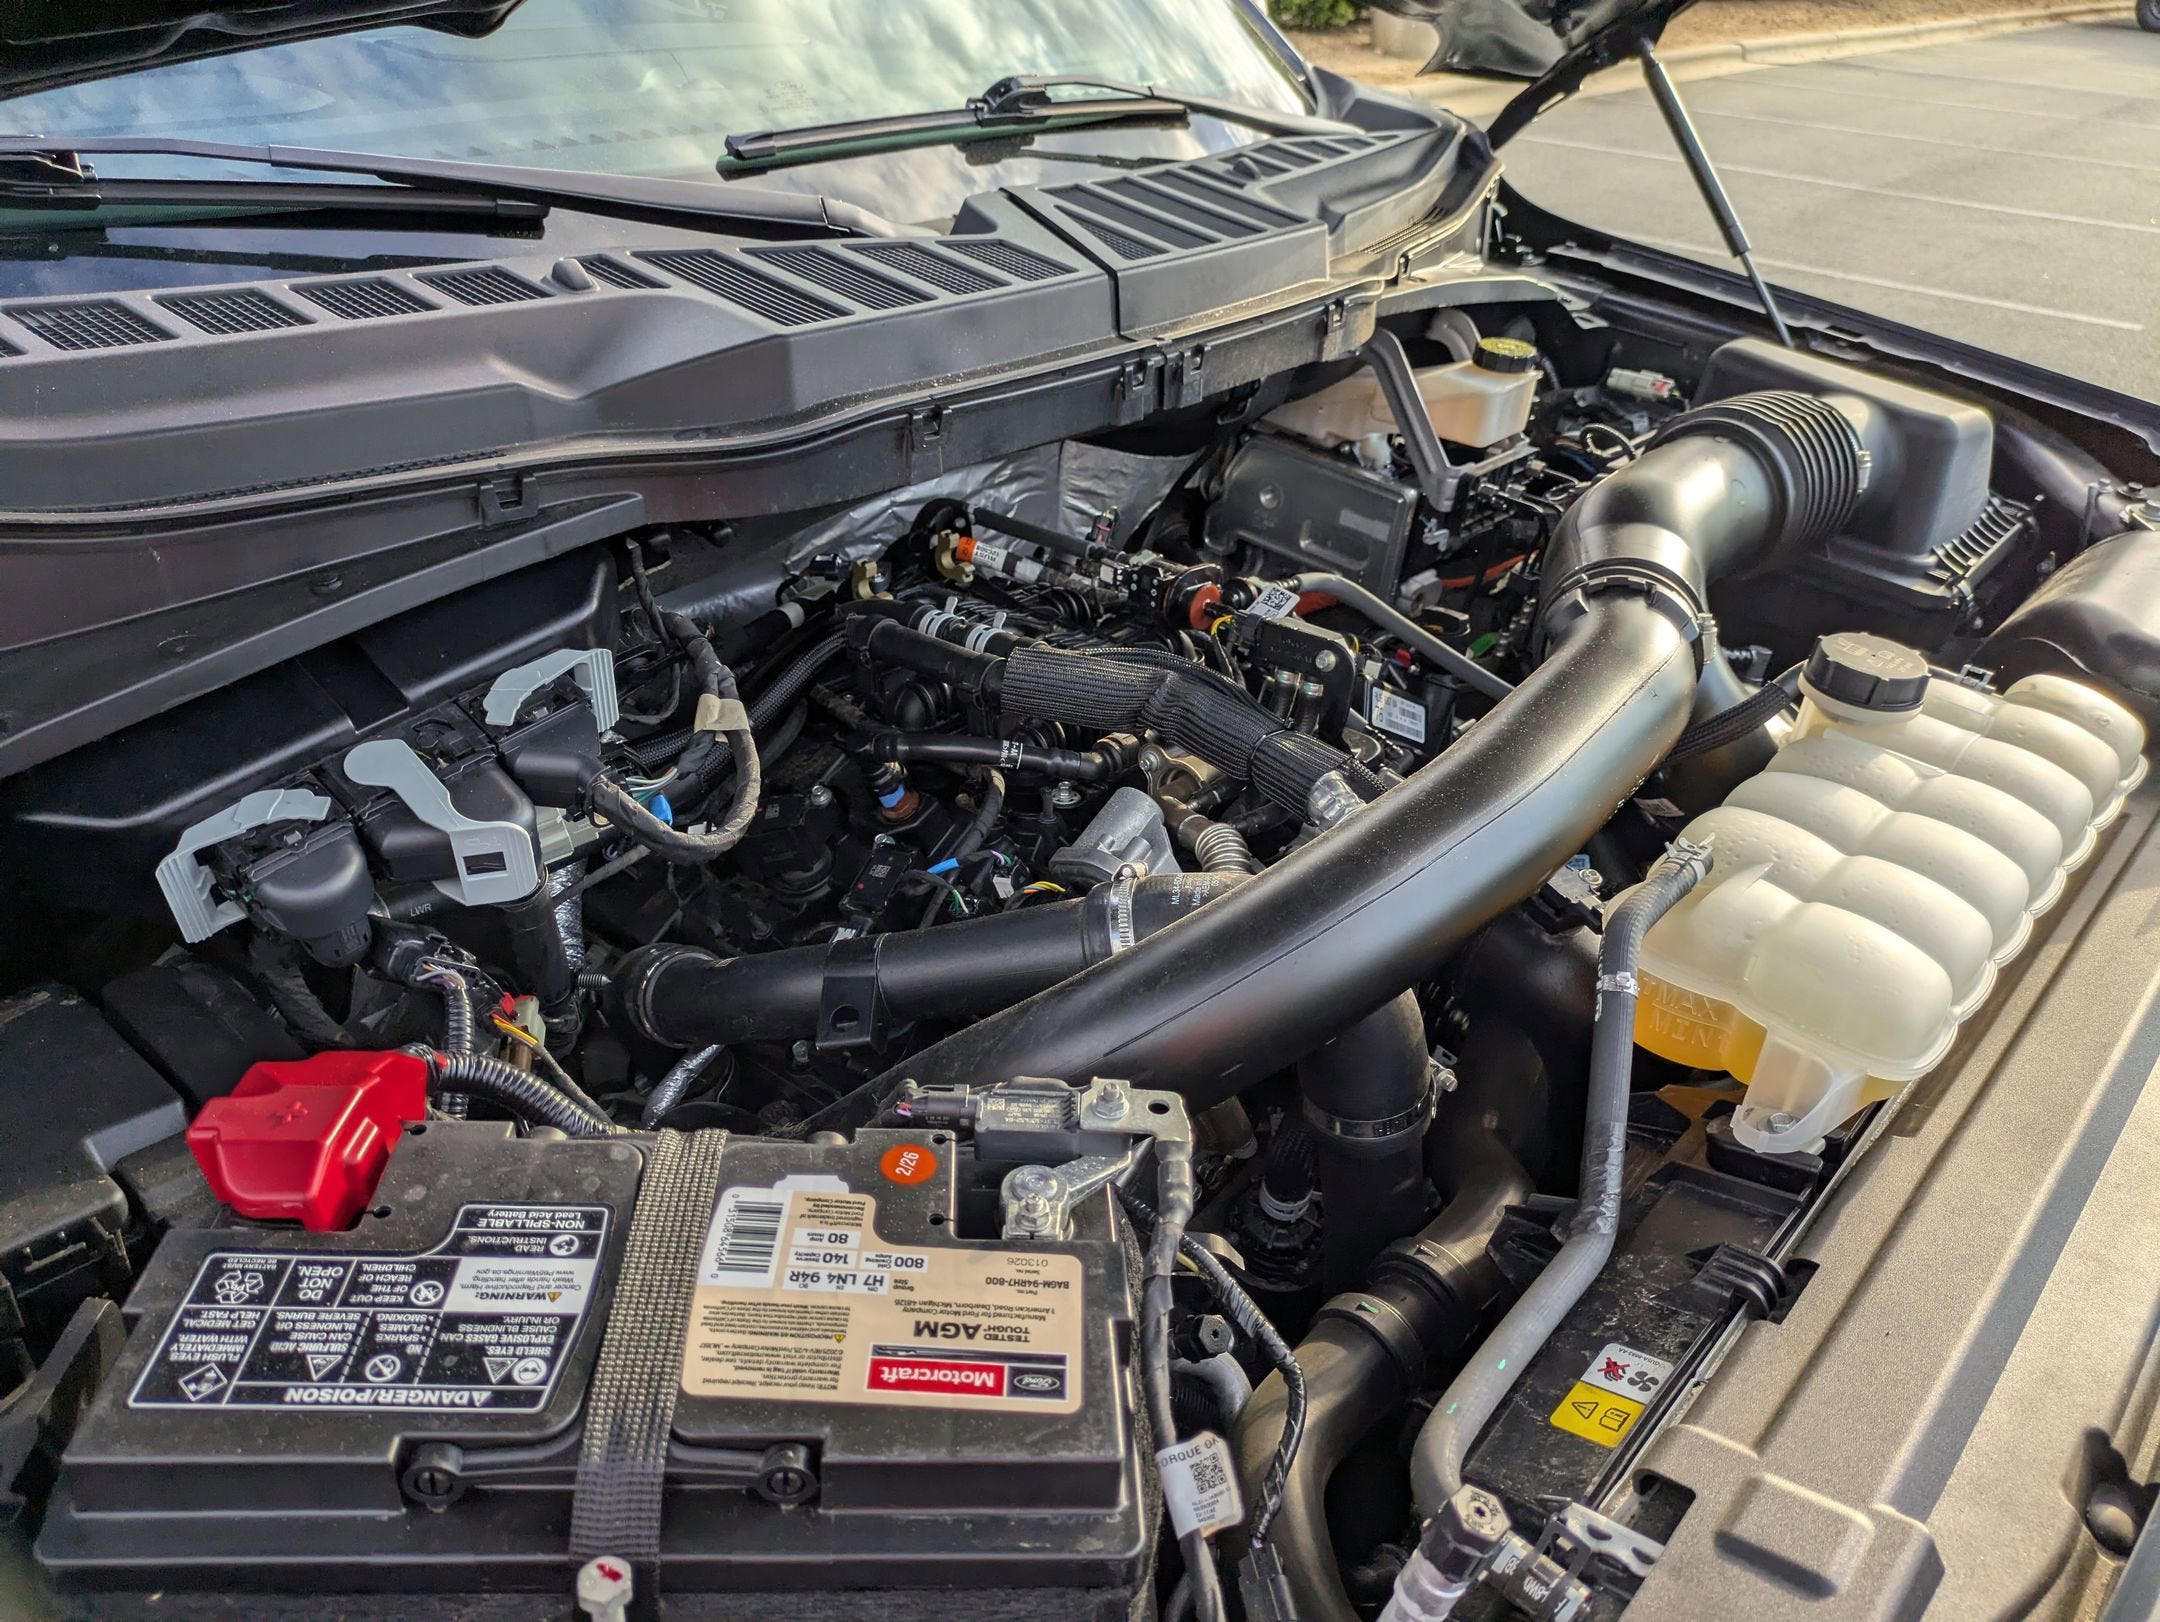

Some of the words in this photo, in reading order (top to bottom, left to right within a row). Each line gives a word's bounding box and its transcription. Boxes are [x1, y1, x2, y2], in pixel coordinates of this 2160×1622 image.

[410, 903, 432, 917] LWR
[1655, 983, 1719, 1022] MAX
[1650, 1007, 1709, 1048] MIN
[895, 1151, 920, 1177] 2/26
[487, 1209, 527, 1219] Battery
[528, 1211, 553, 1219] Acid
[555, 1212, 581, 1220] Lead
[477, 1218, 585, 1229] NON-SPILLABLE
[468, 1235, 547, 1244] INSTRUCTIONS.
[828, 1233, 849, 1244] 80
[823, 1252, 849, 1265] 140
[894, 1257, 925, 1269] 800
[1007, 1257, 1049, 1267] 013026
[297, 1265, 344, 1276] OPEN.
[361, 1263, 417, 1271] CHILDREN.
[375, 1274, 412, 1282] REACH
[789, 1271, 821, 1283] 94R
[827, 1273, 857, 1285] LN4
[863, 1275, 884, 1286] H7
[298, 1277, 333, 1288] NOT
[985, 1277, 1070, 1289] BAGM-94RH7-800
[370, 1284, 392, 1292] THE
[392, 1284, 408, 1293] OF
[298, 1289, 323, 1301] DO
[349, 1294, 373, 1302] OUT
[374, 1294, 404, 1303] KEEP
[475, 1292, 546, 1300] WARNING:
[200, 1310, 230, 1319] FAST.
[230, 1310, 260, 1319] HELP
[902, 1307, 938, 1316] Company
[939, 1309, 961, 1317] Motor
[962, 1310, 979, 1318] Ford
[1015, 1306, 1050, 1314] American
[275, 1311, 316, 1320] BURNS.
[318, 1312, 361, 1321] SEVERE
[376, 1313, 427, 1322] SMOKING
[502, 1315, 542, 1324] INJURY.
[542, 1316, 560, 1324] OR
[993, 1312, 1046, 1321] Manufactured
[183, 1318, 232, 1328] MEDICAL
[232, 1319, 256, 1329] GET
[275, 1321, 293, 1330] OR
[295, 1322, 357, 1331] BLINDNESS
[378, 1323, 423, 1332] FLAMES
[458, 1323, 519, 1333] BLINDNESS
[521, 1324, 557, 1333] CAUSE
[913, 1320, 982, 1339] AGM
[178, 1333, 219, 1343] WATER.
[220, 1334, 248, 1344] WITH
[288, 1331, 327, 1340] CAUSE
[329, 1332, 352, 1341] CAN
[374, 1333, 419, 1342] SPARKS
[439, 1332, 463, 1342] CAN
[465, 1333, 498, 1343] GASES
[500, 1334, 555, 1344] EXPLOSIVE
[984, 1333, 1030, 1343] TESTED
[169, 1343, 245, 1353] IMMEDIATELY
[269, 1341, 297, 1352] ACID
[297, 1342, 349, 1353] SULFURIC
[405, 1344, 423, 1355] NO
[484, 1345, 514, 1356] EYES.
[515, 1346, 551, 1356] SHIELD
[202, 1352, 240, 1362] FLUSH
[878, 1366, 995, 1388] Motorcraft
[1022, 1375, 1053, 1388] Ford
[284, 1387, 469, 1406] DANGER/POISON
[1160, 1446, 1202, 1467] ORQUE
